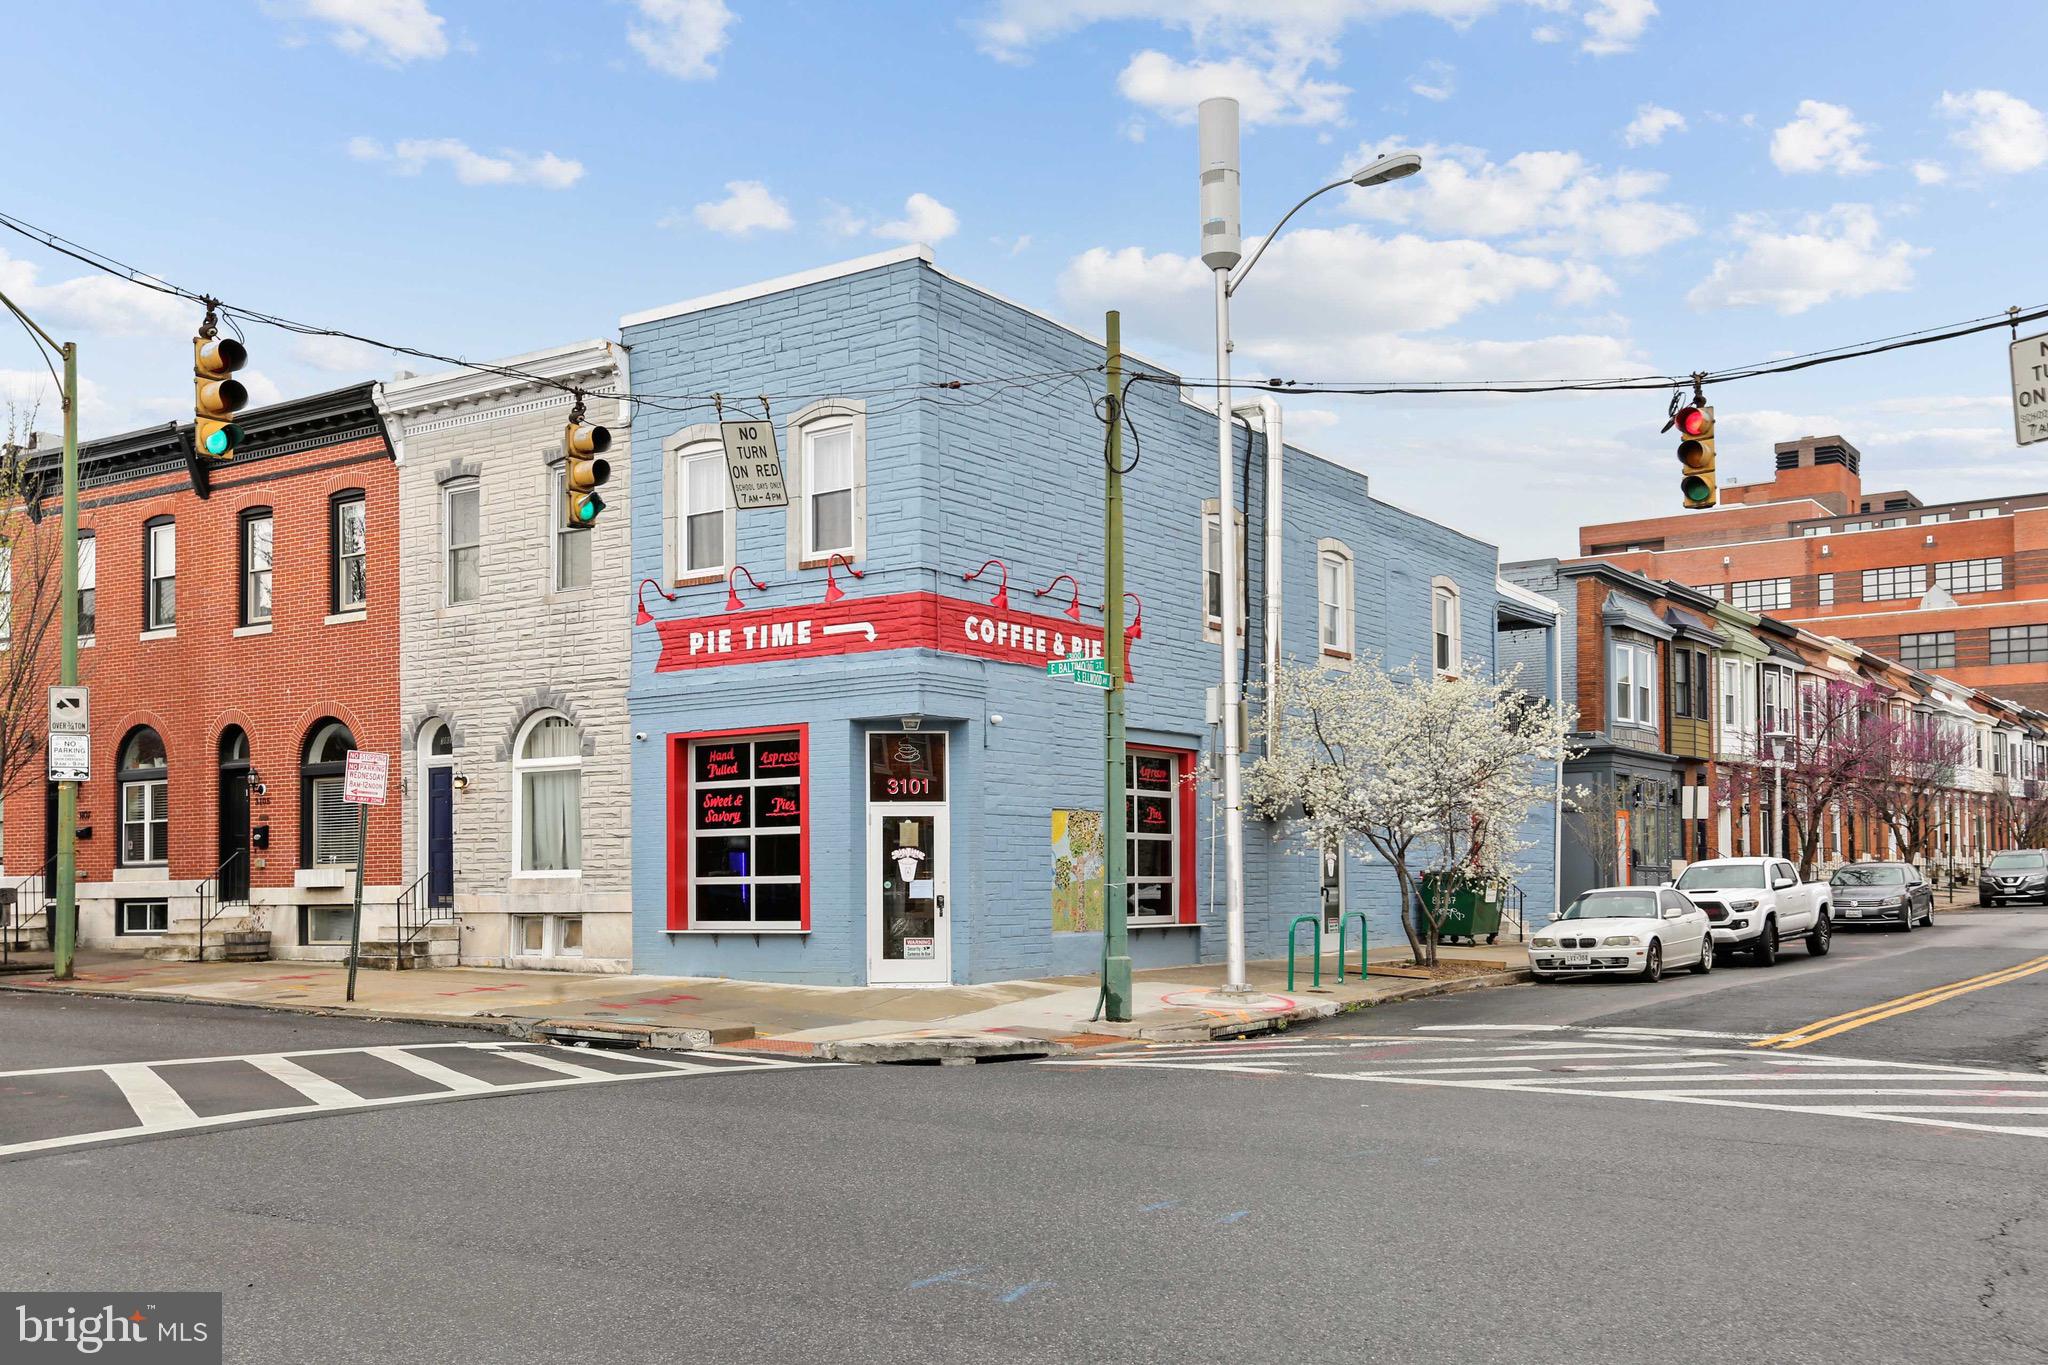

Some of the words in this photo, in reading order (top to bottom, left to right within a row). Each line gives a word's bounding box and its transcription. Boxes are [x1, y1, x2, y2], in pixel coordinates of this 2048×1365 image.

[2019, 387, 2046, 408] ON
[738, 427, 757, 440] NO
[736, 445, 768, 459] TURN
[732, 465, 749, 479] ON
[755, 463, 779, 477] RED
[735, 483, 755, 492] SCHOOL
[756, 482, 768, 491] DAYS
[770, 481, 782, 489] ONLY
[689, 628, 732, 656] PIE
[743, 620, 812, 650] TIME
[964, 615, 1047, 653] COFFEE
[1053, 632, 1066, 656] &
[1071, 635, 1102, 659] PIE
[1082, 672, 1103, 686] ELLWOOD
[52, 722, 66, 730] OVER
[75, 722, 86, 730] TON
[53, 747, 86, 755] PARKING
[350, 752, 359, 760] NO
[709, 747, 736, 763] Hand
[350, 771, 384, 781] WEDNESDAY
[360, 764, 385, 773] PARKING
[707, 761, 738, 778] Pulled
[887, 777, 929, 795] 3101
[703, 793, 732, 809] Sweet
[734, 794, 743, 807] &
[771, 797, 796, 813] Pies
[705, 809, 742, 825] Savory
